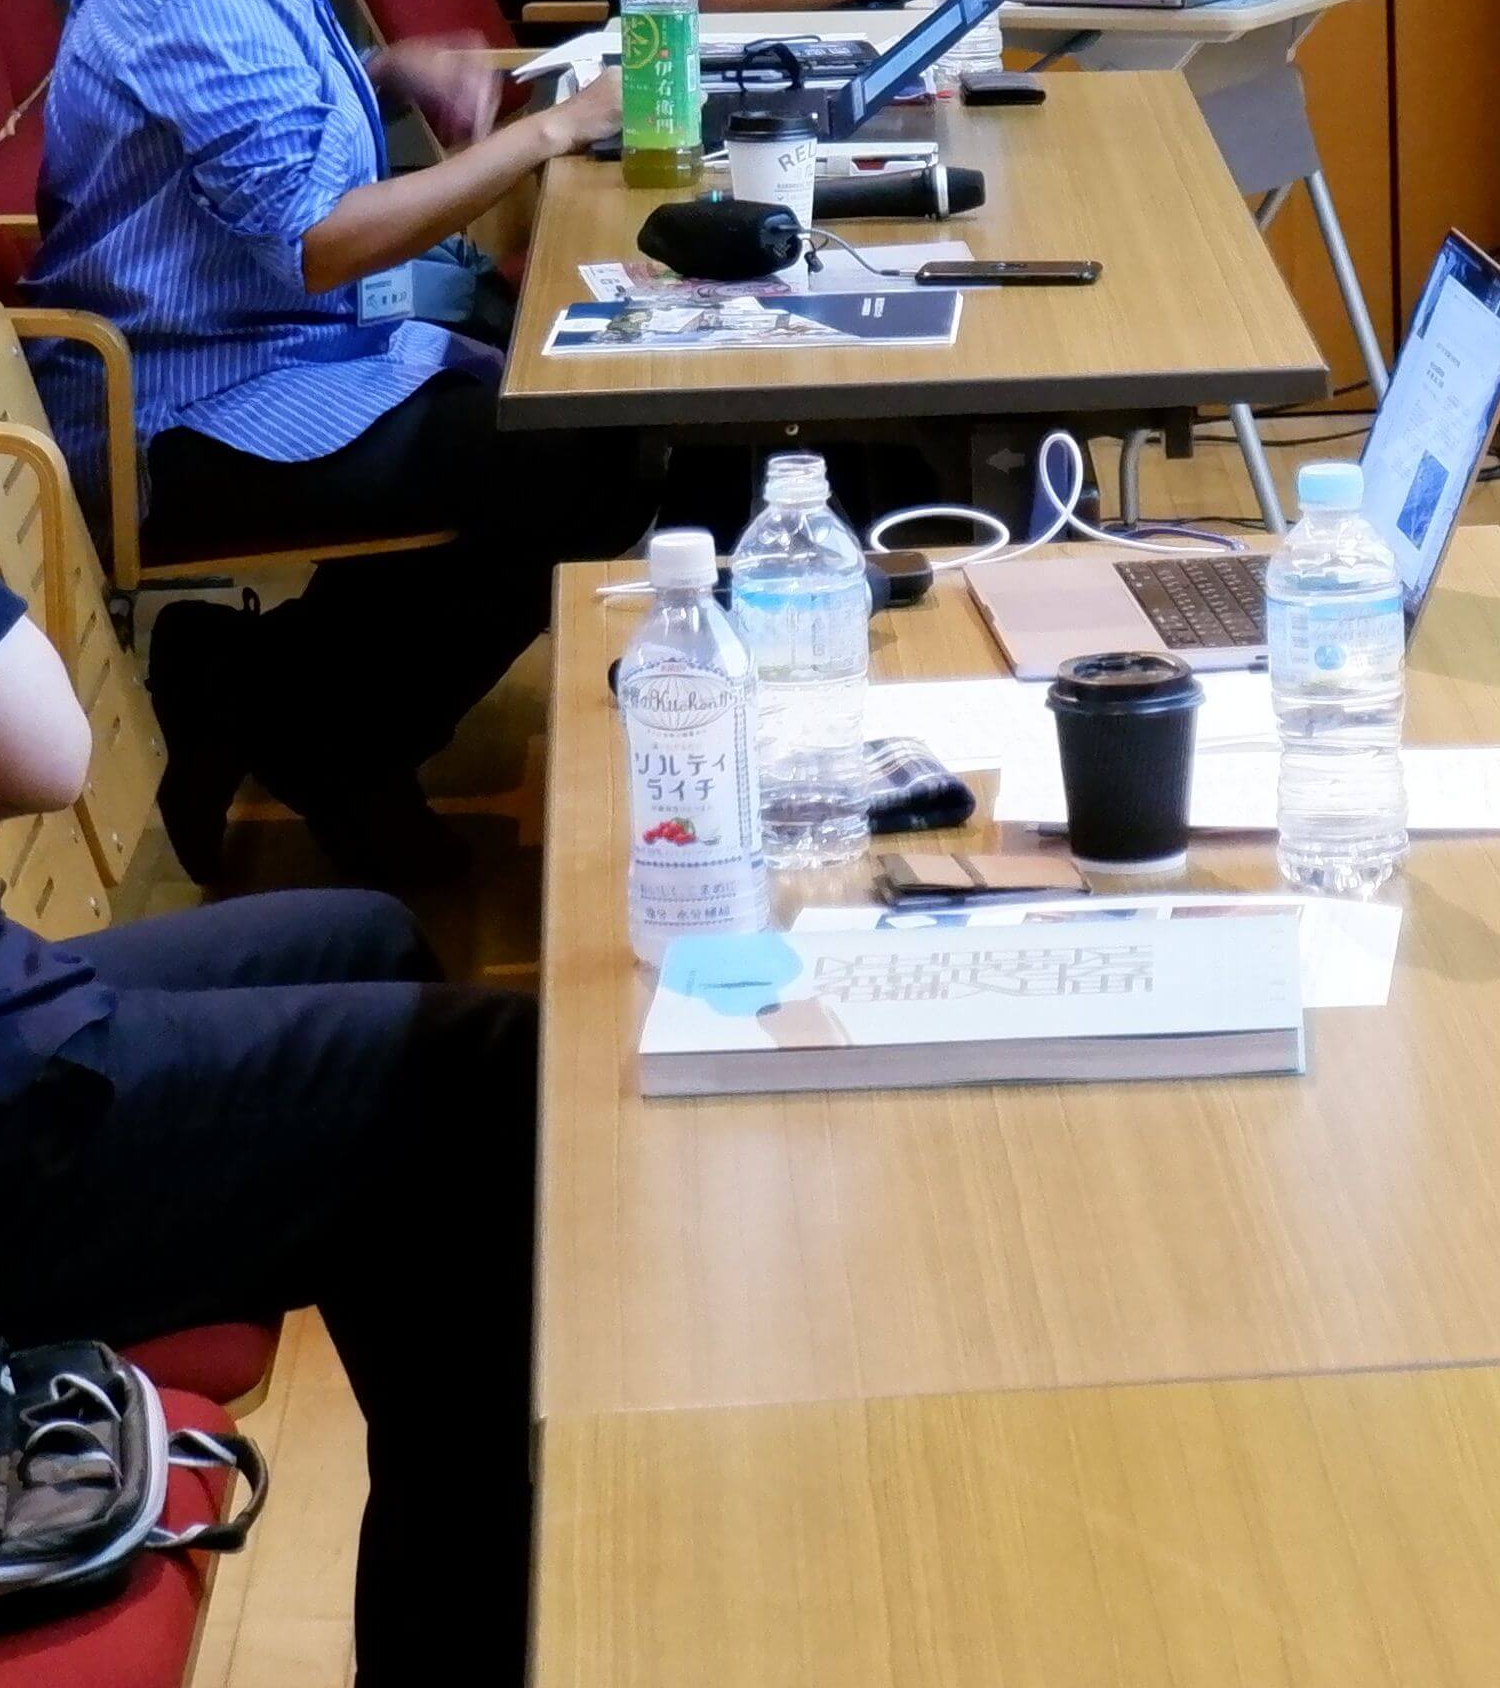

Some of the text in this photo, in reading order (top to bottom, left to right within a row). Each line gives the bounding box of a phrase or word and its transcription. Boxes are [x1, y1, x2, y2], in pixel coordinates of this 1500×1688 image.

[635, 753, 726, 777] ソルティ
[647, 777, 716, 802] ライチ
